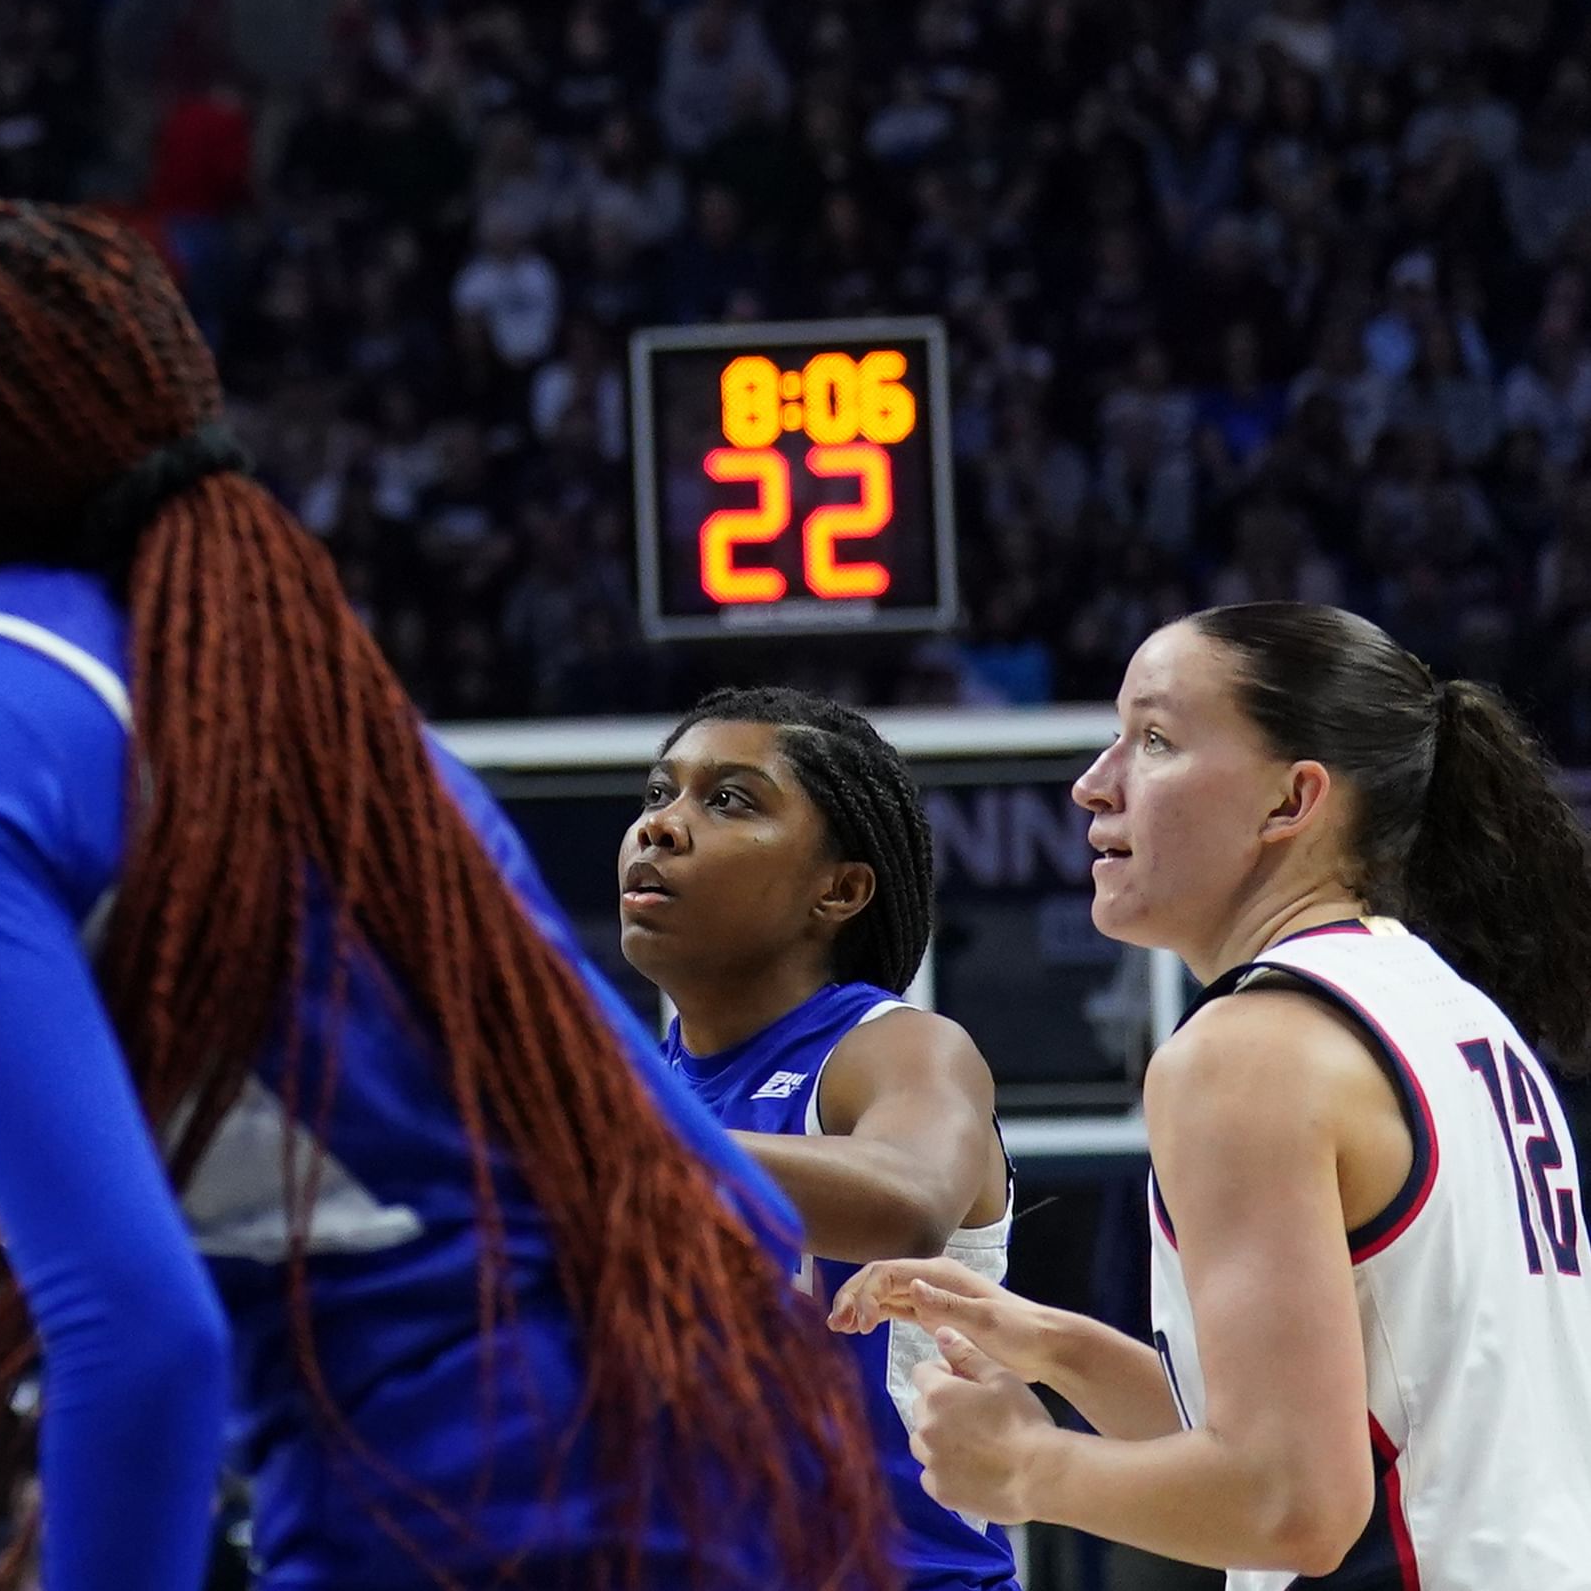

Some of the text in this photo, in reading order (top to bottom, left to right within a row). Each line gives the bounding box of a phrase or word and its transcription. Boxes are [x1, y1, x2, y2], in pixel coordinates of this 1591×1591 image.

[720, 350, 915, 449] 8:06
[699, 442, 895, 605] 22
[1456, 1036, 1582, 1277] 12
